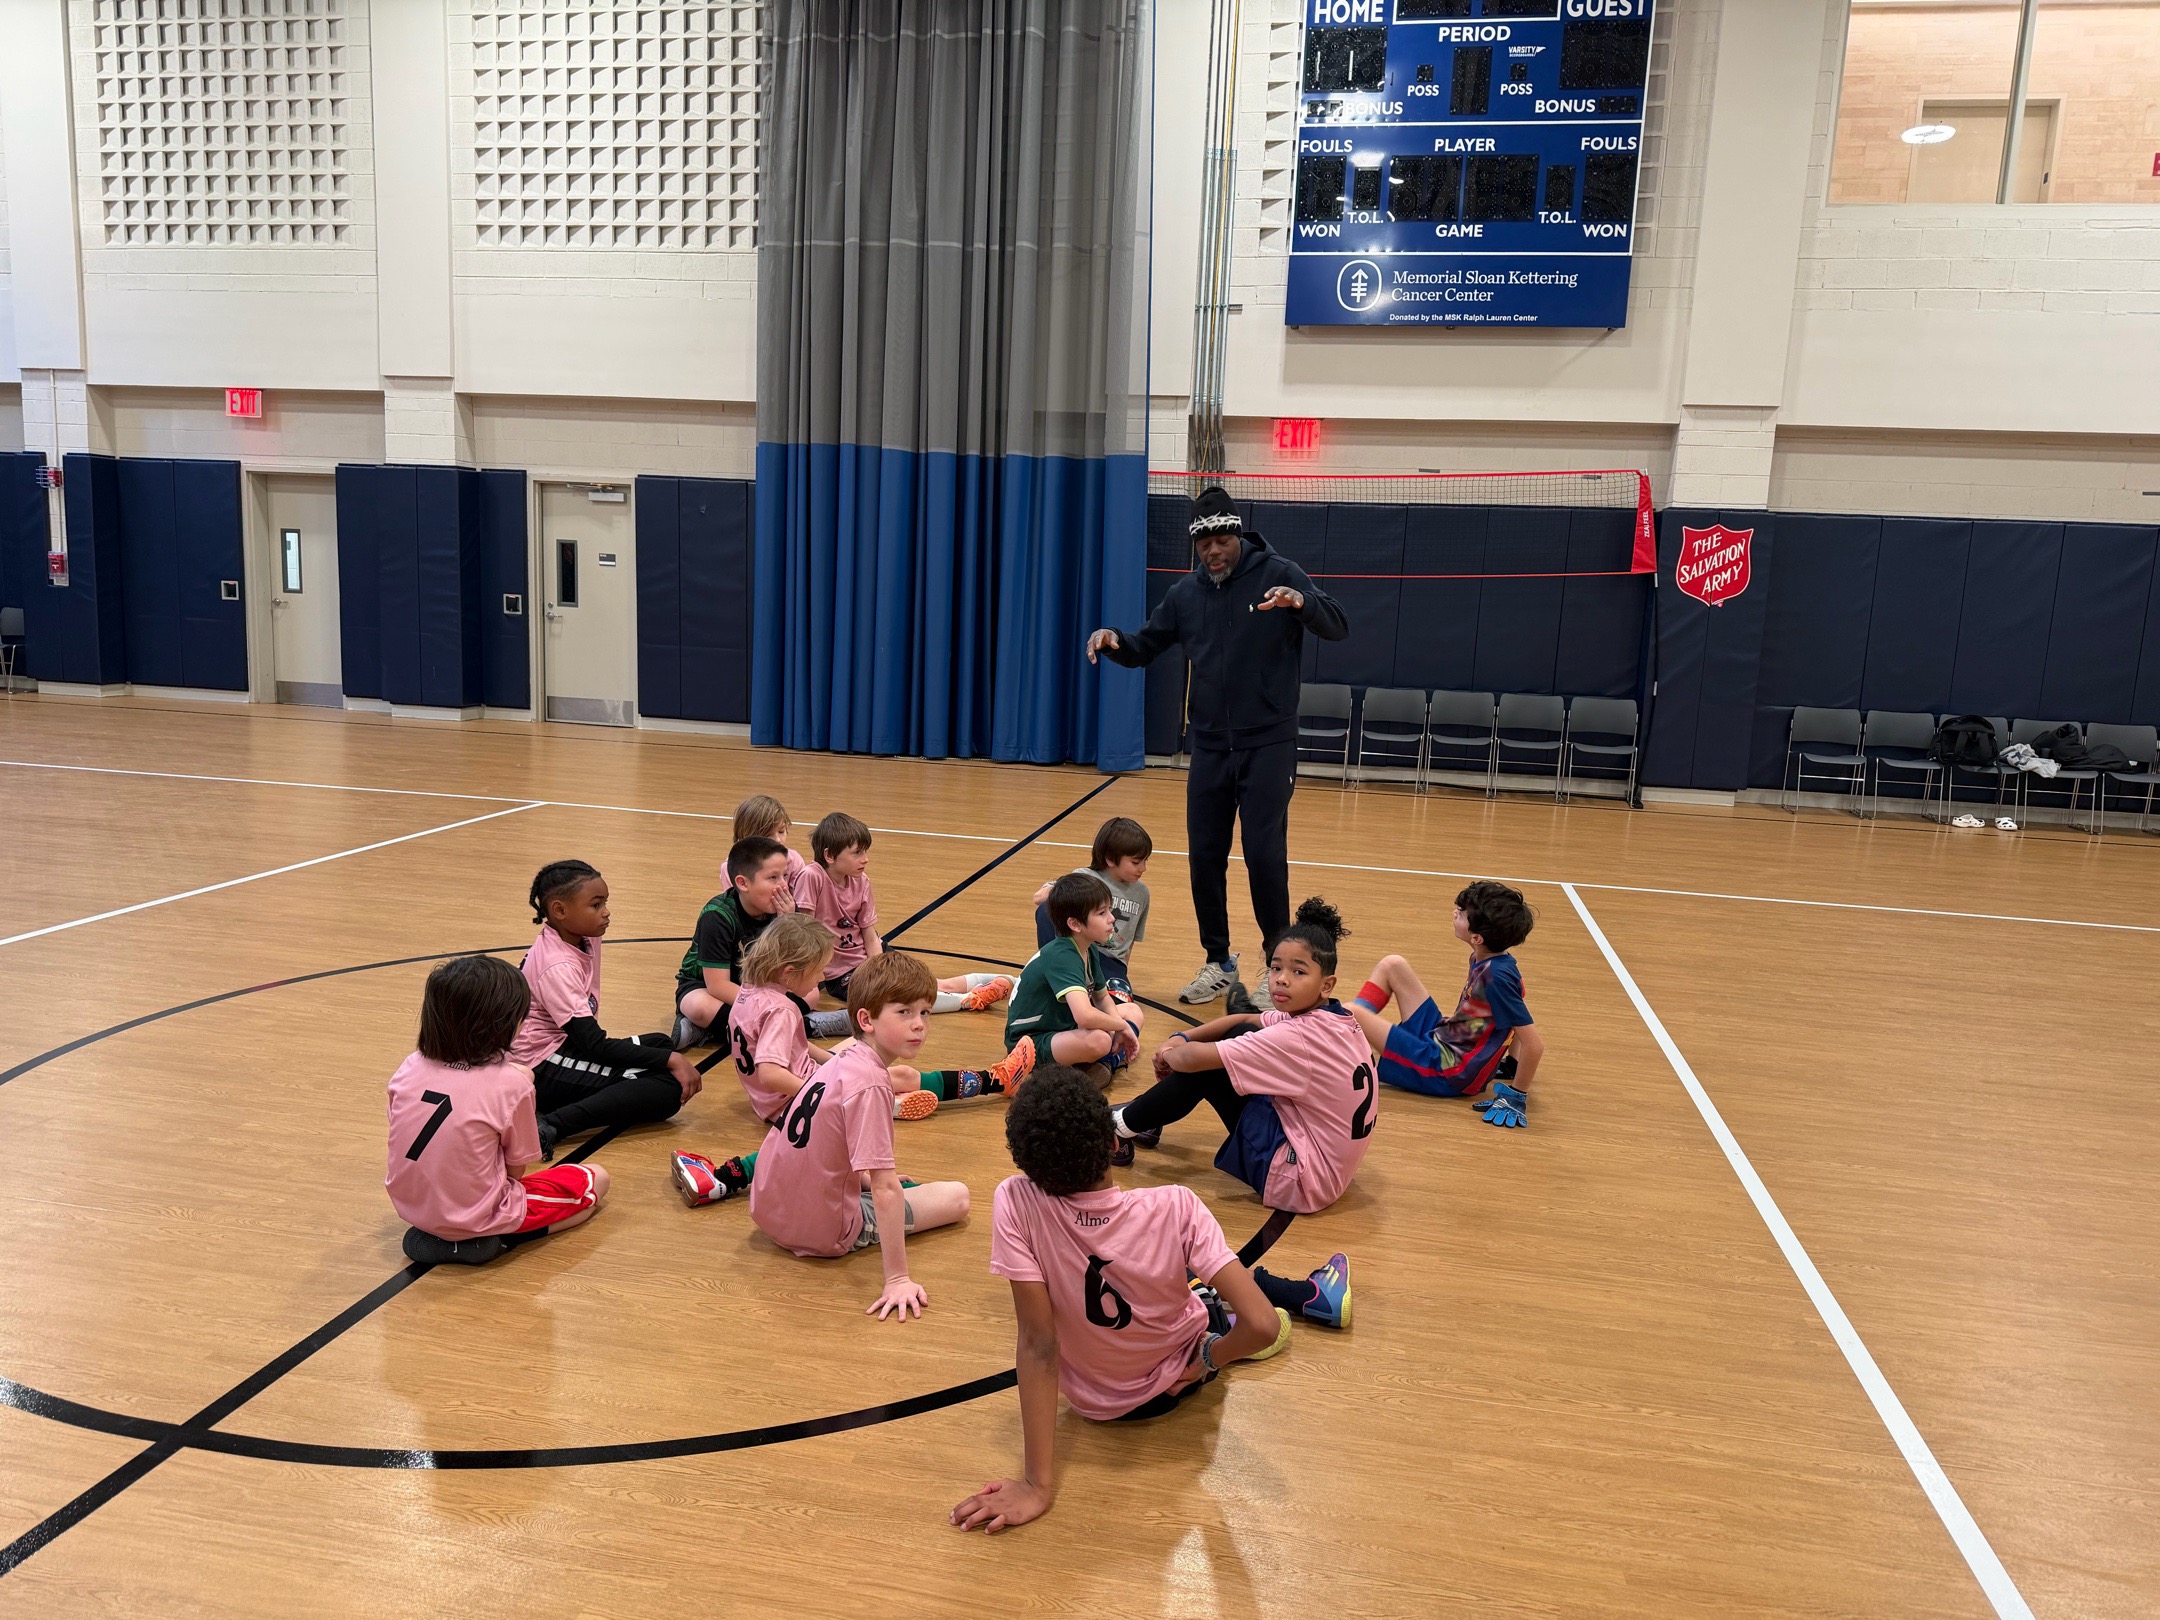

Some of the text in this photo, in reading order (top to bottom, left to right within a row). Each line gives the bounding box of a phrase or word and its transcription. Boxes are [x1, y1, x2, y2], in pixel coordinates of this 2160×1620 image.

[1314, 0, 1384, 23] HOME
[1438, 26, 1511, 42] PERIOD
[1407, 85, 1439, 96] POSS
[1500, 83, 1533, 95] POSS
[1344, 101, 1403, 115] BONUS
[1534, 99, 1596, 113] BONUS
[1300, 139, 1353, 153] FOULS
[1434, 138, 1496, 152] PLAYER
[1581, 136, 1637, 150] FOULS
[1347, 212, 1384, 224] T.O.L.
[1538, 211, 1576, 224] T.O.L.
[1299, 224, 1341, 237] WON
[1435, 224, 1484, 238] GAME
[1582, 224, 1627, 237] WON
[1392, 270, 1579, 288] Memorial Sloan Kettering
[1391, 287, 1494, 302] Cancer Center
[1389, 313, 1419, 321] Donated
[1421, 313, 1430, 323] by
[1431, 313, 1443, 321] the
[1463, 314, 1484, 323] Ralph
[1486, 314, 1511, 322] Lauren
[1513, 314, 1538, 322] Center
[230, 390, 258, 414] EXIT
[1280, 420, 1315, 448] EXIT
[1692, 532, 1723, 557] THE
[1680, 538, 1746, 583] SALVATION
[1701, 561, 1743, 596] ARMY
[1351, 1054, 1379, 1140] 2
[404, 1089, 453, 1162] 7
[1074, 1211, 1110, 1227] Almo
[1084, 1254, 1133, 1331] 6
